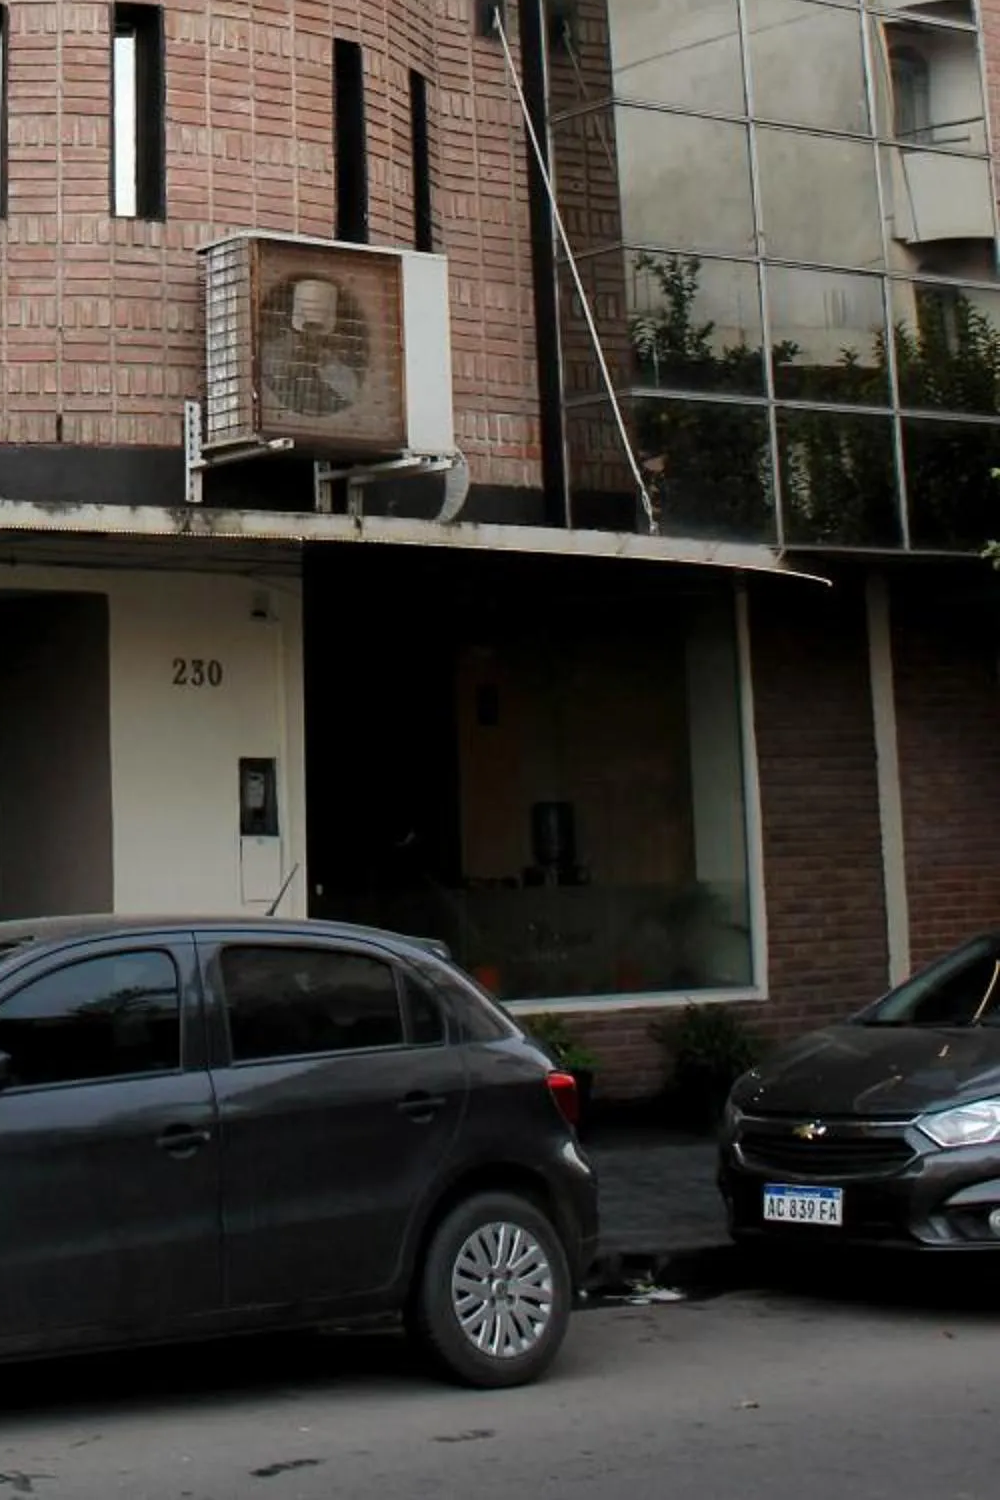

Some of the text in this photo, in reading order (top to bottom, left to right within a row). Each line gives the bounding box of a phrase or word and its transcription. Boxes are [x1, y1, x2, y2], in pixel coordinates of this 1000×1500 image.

[172, 657, 223, 688] 230
[767, 1196, 838, 1221] AC 839 FA
